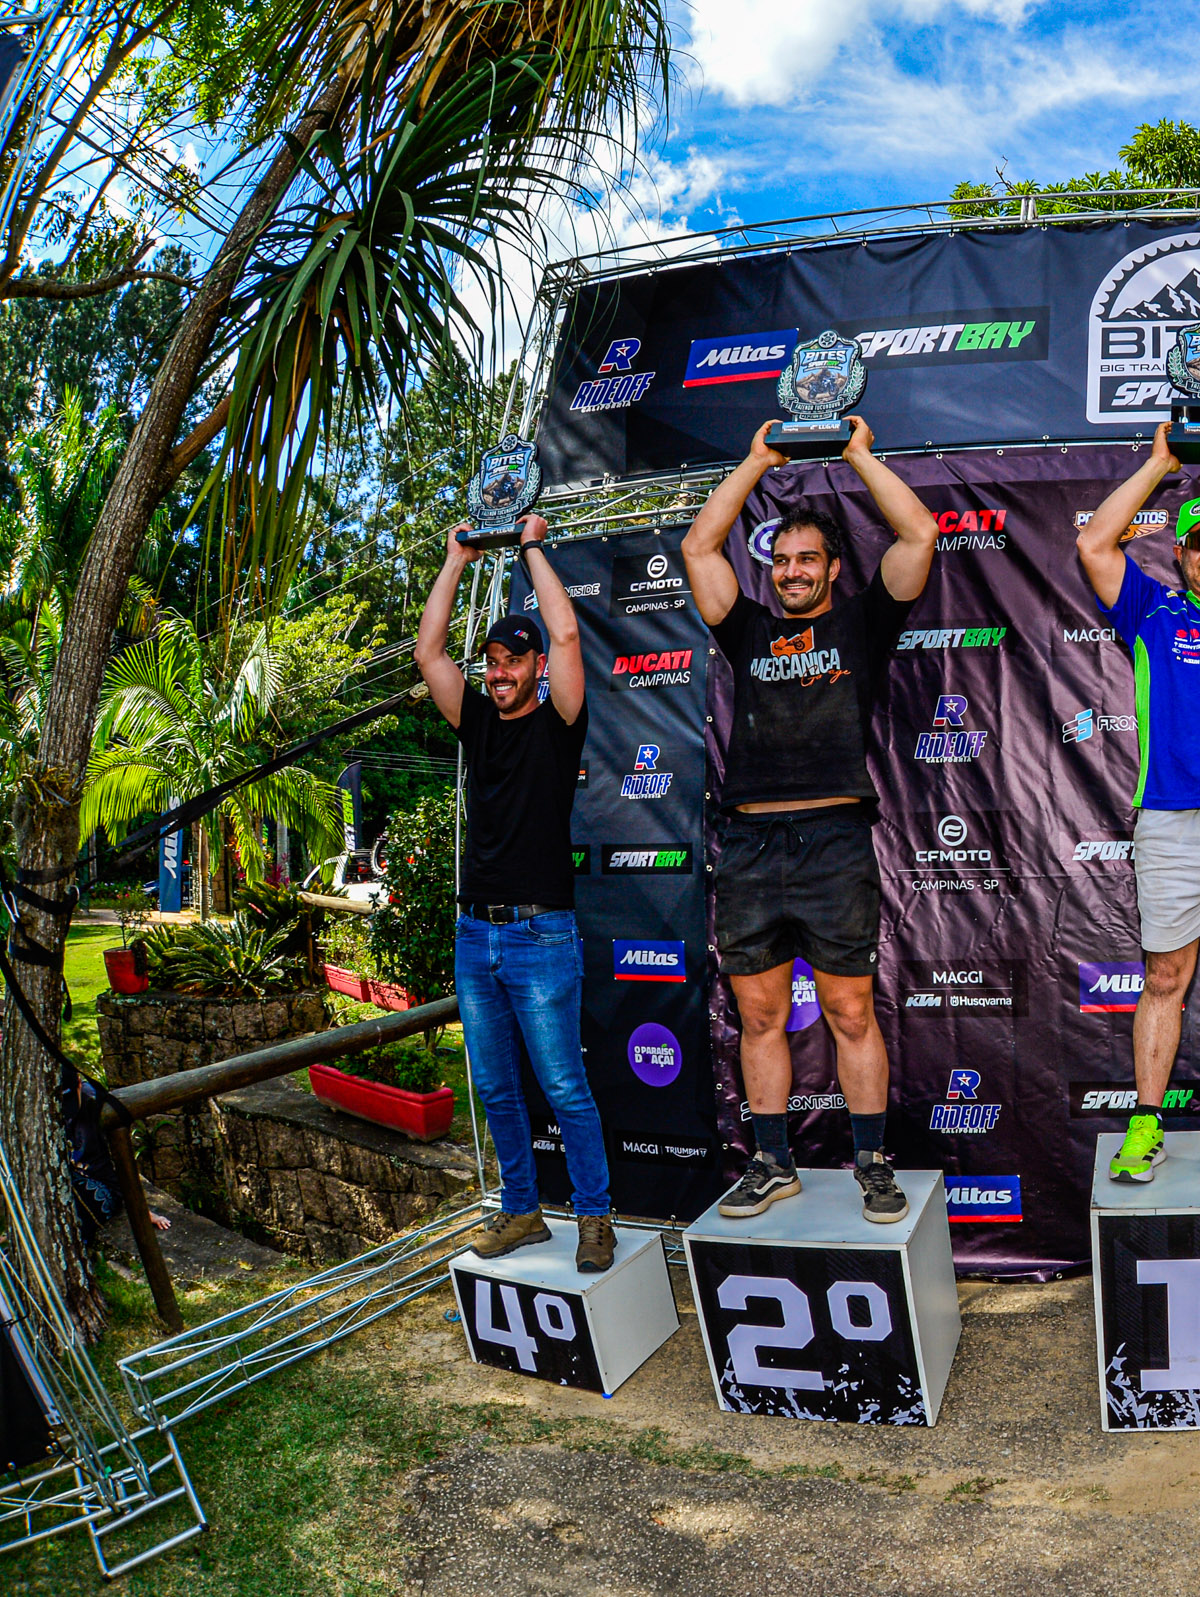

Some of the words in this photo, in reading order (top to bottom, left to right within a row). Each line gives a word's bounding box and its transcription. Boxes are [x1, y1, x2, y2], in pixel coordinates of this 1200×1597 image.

[854, 320, 1036, 358] SPORTBAY
[696, 344, 786, 369] Mitas
[803, 350, 847, 365] BITES
[1101, 364, 1125, 373] BIG
[1129, 364, 1166, 373] TRAI
[488, 453, 525, 471] BITES
[934, 509, 1007, 534] CATI
[1133, 510, 1168, 525] OTOS
[934, 535, 1007, 552] AMPINAS
[630, 578, 682, 592] CFMOTO
[625, 600, 669, 614] CAMPINAS
[674, 599, 686, 609] SP
[897, 627, 1007, 650] SPORTBAY
[1064, 628, 1116, 642] MAGGI
[612, 650, 693, 675] DUCATI
[750, 648, 841, 682] MECCANICA
[629, 670, 691, 688] CAMPINAS
[609, 850, 687, 868] SPORTBAY
[916, 849, 992, 862] CFMOTO
[912, 880, 975, 891] CAMPINAS
[983, 879, 999, 890] SP
[620, 950, 679, 966] Mitas
[933, 971, 983, 984] MAGGI
[905, 993, 942, 1007] KTM
[960, 995, 1012, 1009] Husqvarna
[623, 1141, 658, 1155] MAGGI
[665, 1146, 700, 1158] TRIUMPH
